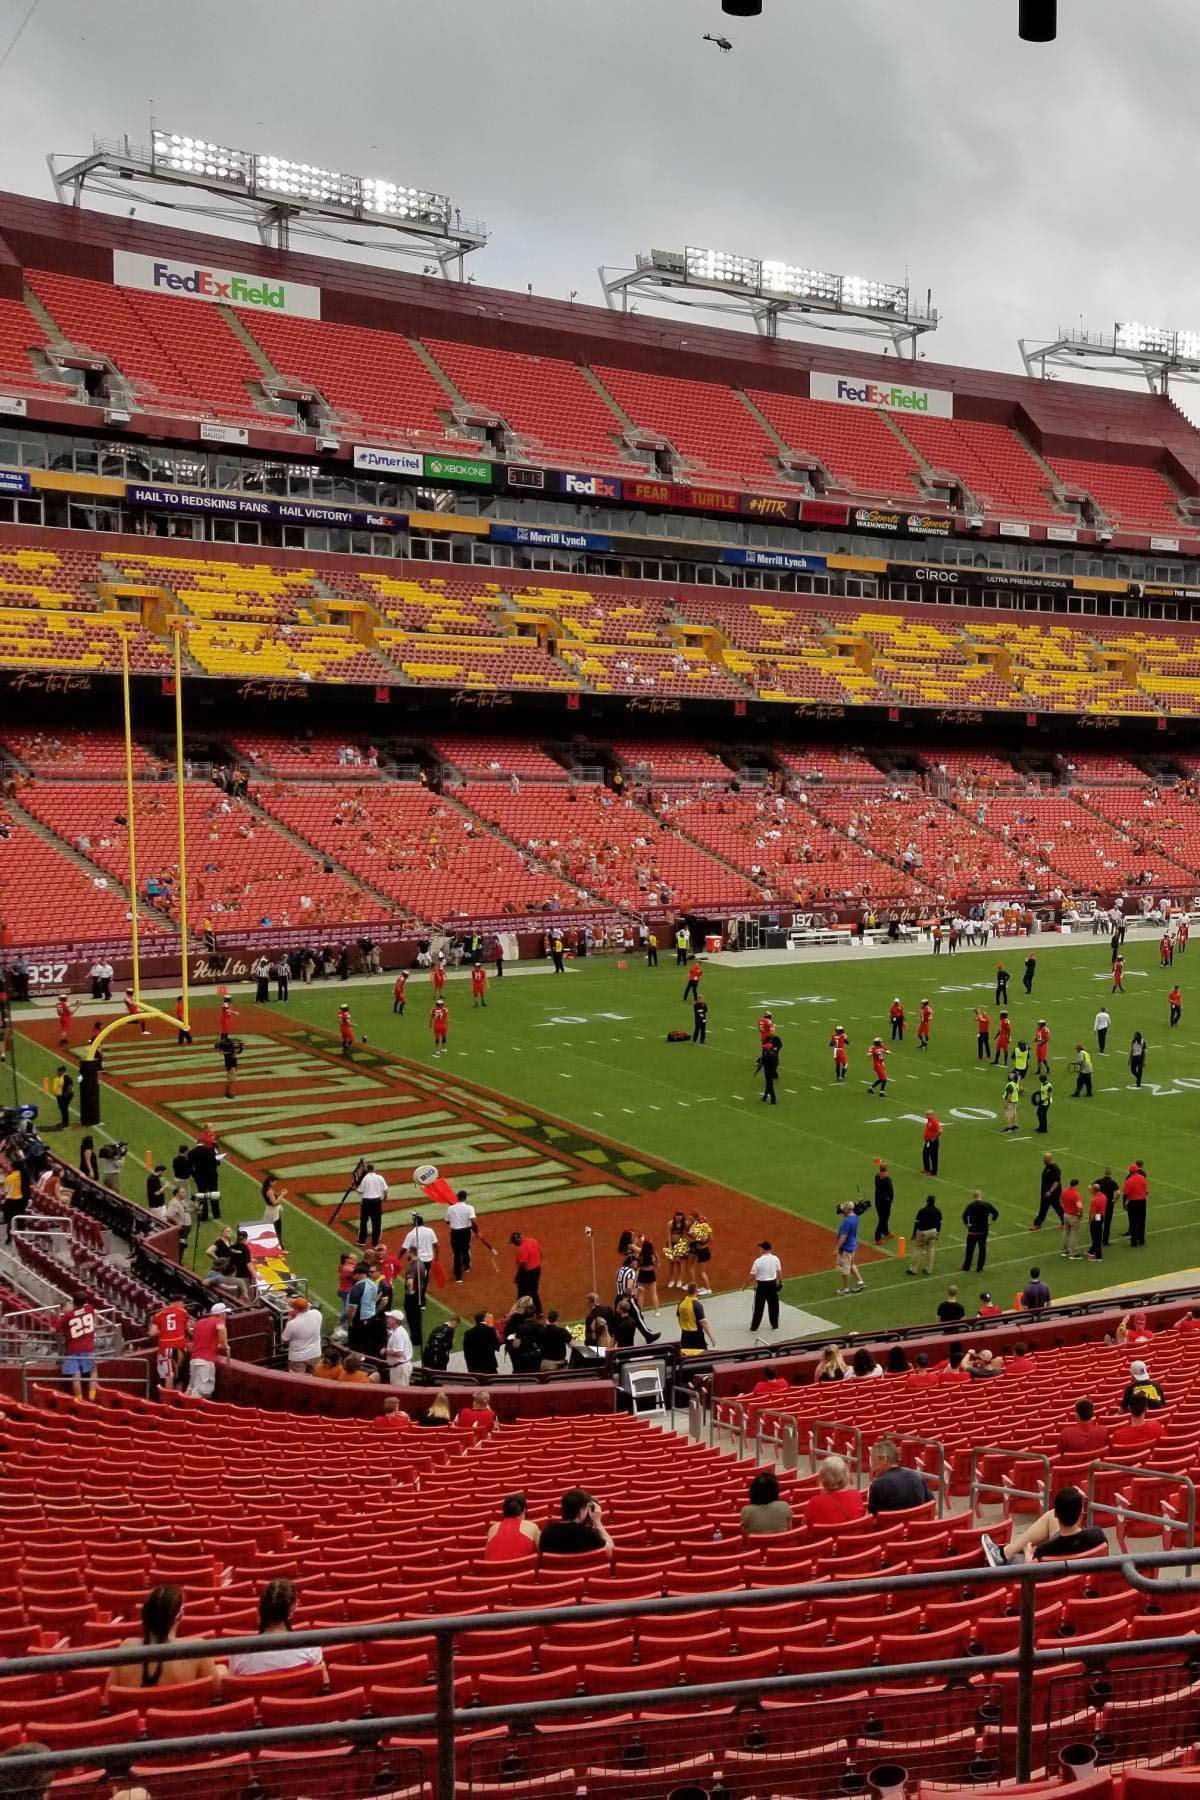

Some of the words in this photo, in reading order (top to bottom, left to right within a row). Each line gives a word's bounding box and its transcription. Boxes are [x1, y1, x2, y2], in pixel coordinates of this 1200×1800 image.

[153, 262, 285, 309] FedExField
[837, 380, 928, 412] FedExField
[368, 453, 420, 469] Ameritel
[443, 463, 466, 475] XBOX
[467, 466, 487, 477] ONE
[566, 474, 616, 497] FedEx
[136, 490, 162, 503] HAIL
[163, 493, 179, 504] TO
[181, 495, 237, 510] REDSKINS
[240, 501, 270, 514] FANS.
[279, 505, 303, 518] HAIL
[304, 508, 352, 522] VICTORY!
[366, 514, 396, 526] FedEx
[856, 520, 898, 531] WASHINGTON
[908, 526, 949, 535] WASHINGTON
[530, 531, 559, 543] Merrill
[561, 534, 587, 547] Lynch
[757, 553, 783, 565] Merrill
[784, 556, 807, 568] Lynch
[986, 575, 1009, 584] ULTRA
[1010, 577, 1042, 587] PREMIUM
[1043, 580, 1066, 588] VODKA
[792, 913, 815, 928] 197
[26, 964, 69, 984] 937
[232, 960, 248, 976] to
[69, 1313, 96, 1339] 29
[166, 1313, 177, 1331] 6
